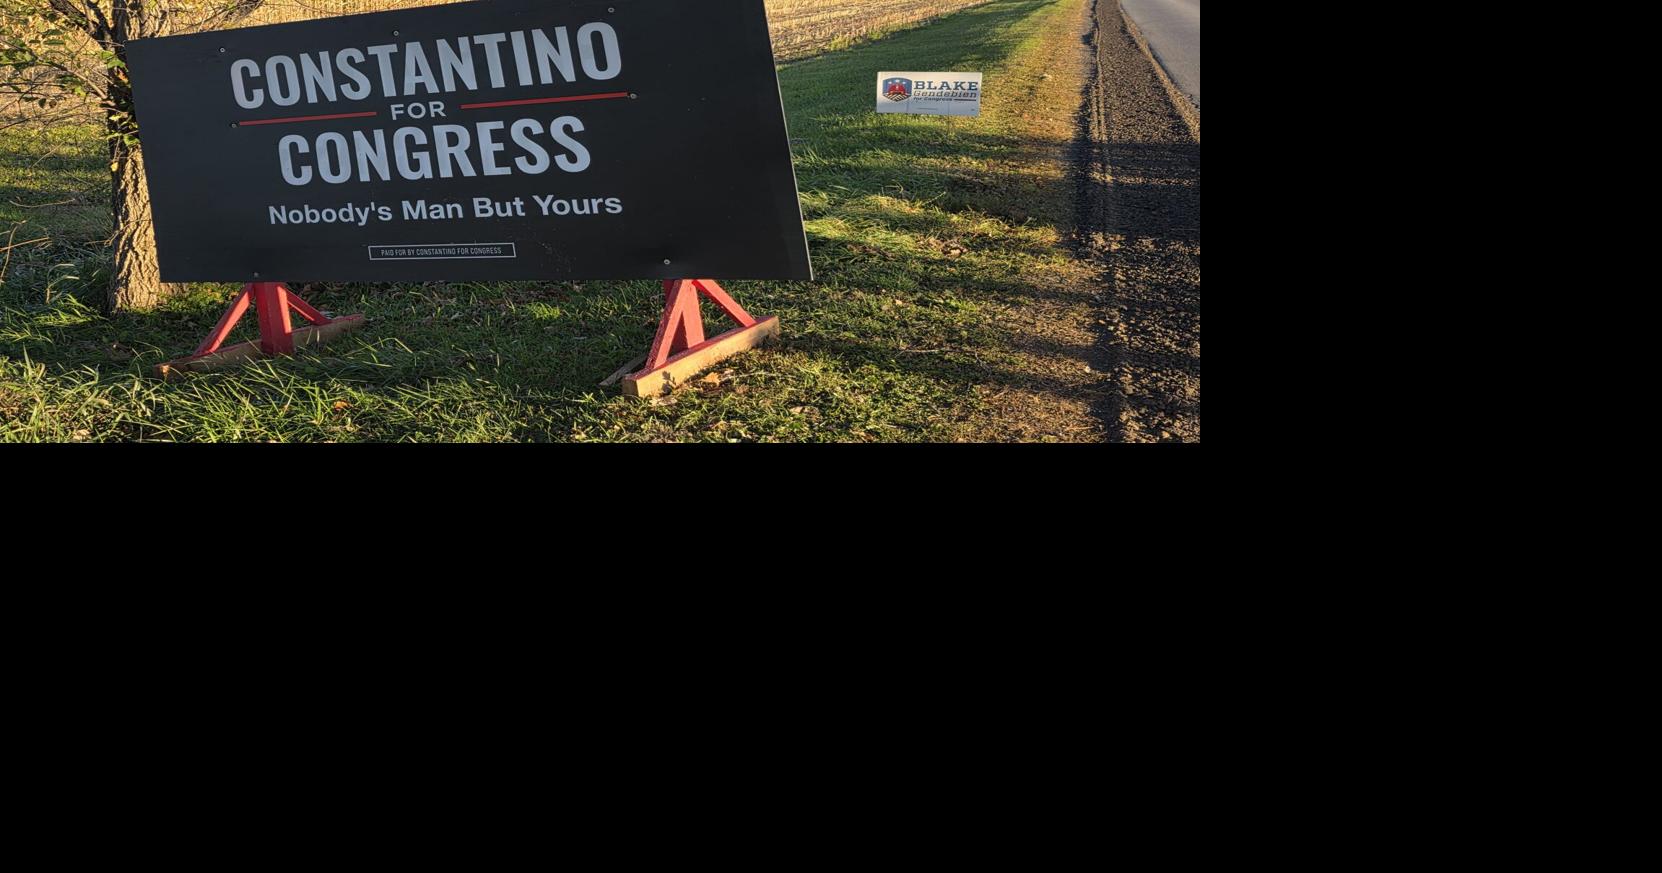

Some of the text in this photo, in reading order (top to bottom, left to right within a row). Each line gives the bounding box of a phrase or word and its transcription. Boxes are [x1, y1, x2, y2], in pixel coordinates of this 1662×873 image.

[230, 21, 622, 110] CONSTANTINO
[913, 90, 977, 98] Gendebien
[914, 81, 978, 91] BLAKE
[390, 101, 446, 121] FOR
[278, 115, 591, 186] CONGRESS
[268, 194, 623, 226] Nobody's Man But Yours
[408, 248, 415, 256] BY
[416, 248, 456, 256] CONSTANTINO
[457, 247, 469, 255] FOR
[470, 247, 502, 255] CONGRESS
